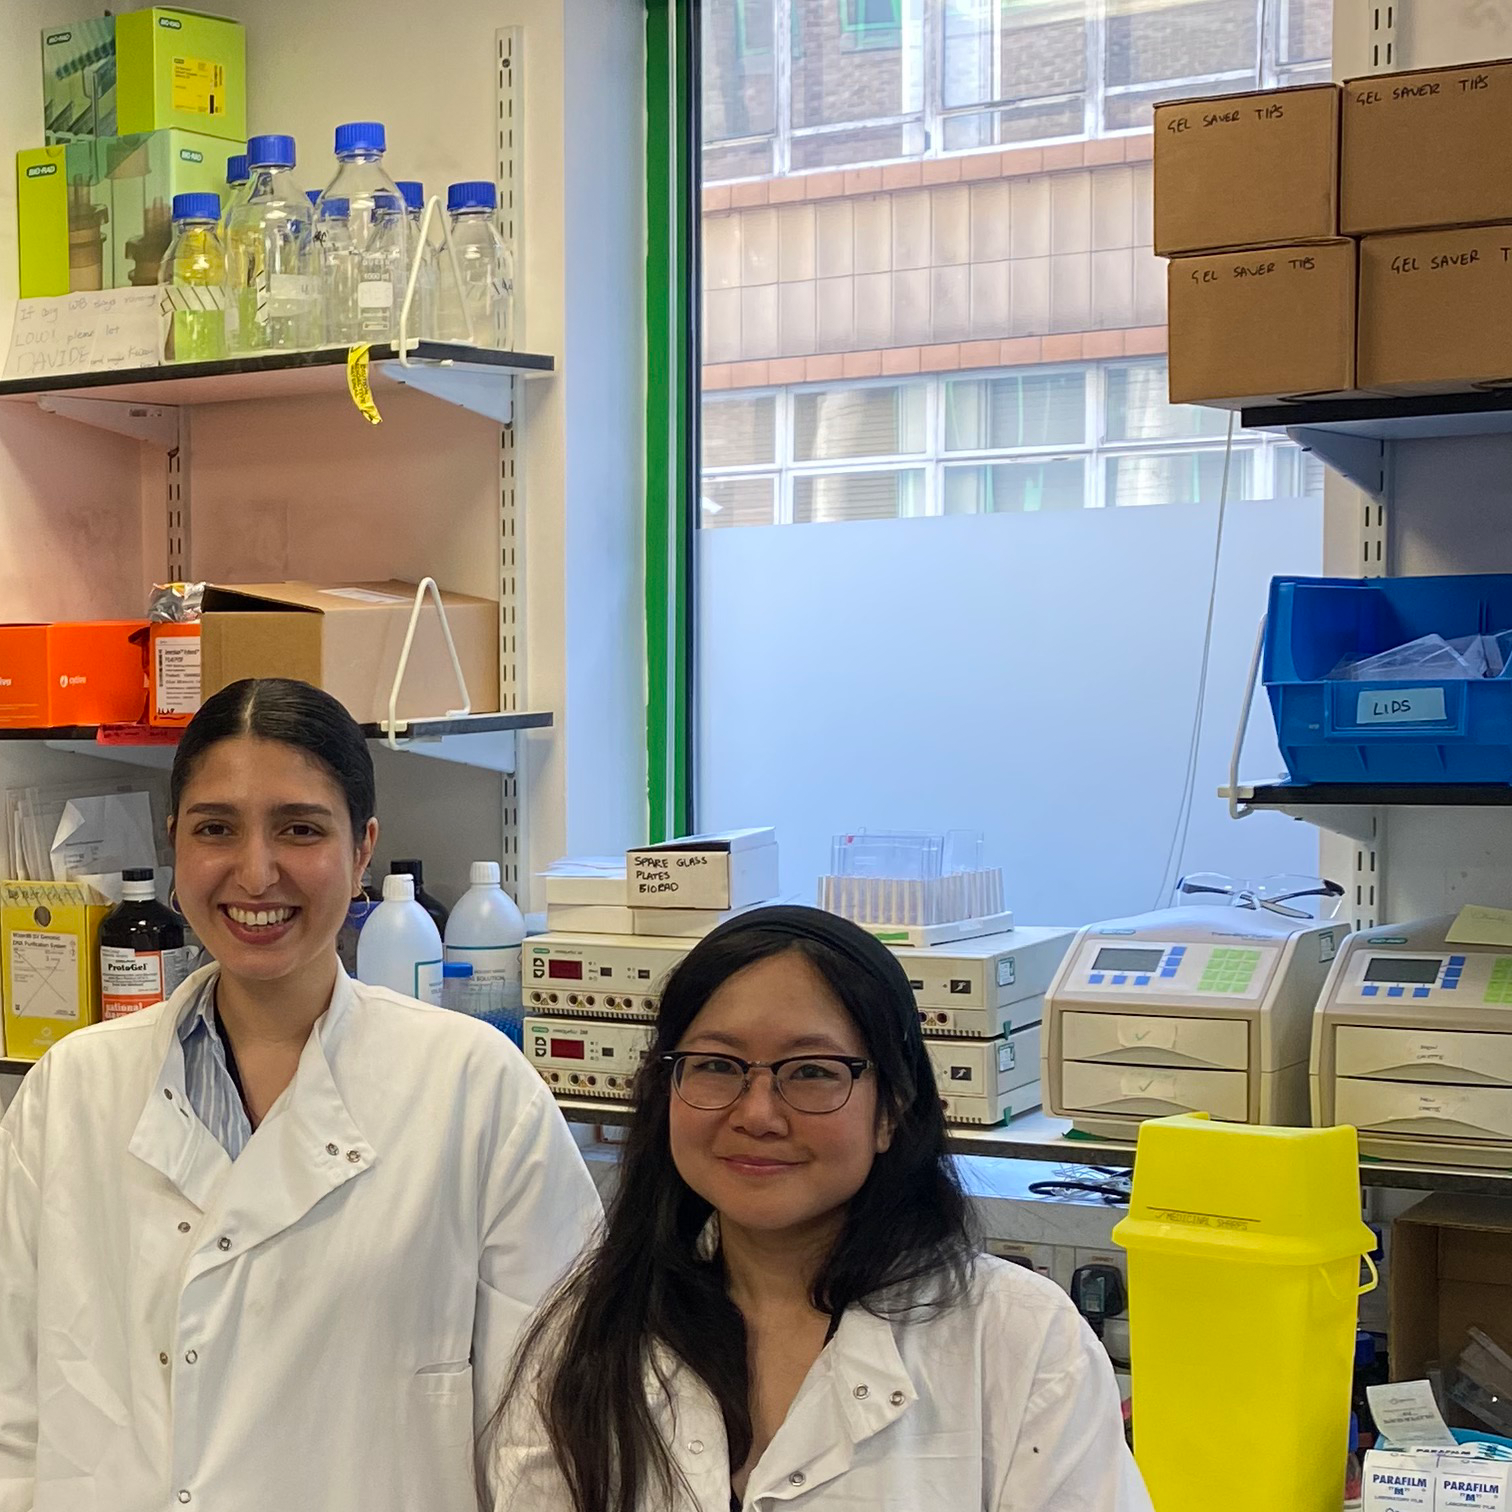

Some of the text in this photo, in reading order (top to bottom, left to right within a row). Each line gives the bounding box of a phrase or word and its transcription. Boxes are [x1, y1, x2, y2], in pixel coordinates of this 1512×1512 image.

[1356, 75, 1488, 106] GEL SAVER TIPS
[1167, 105, 1284, 133] GEL SAVER TIPS
[28, 165, 56, 177] BIO-RAD
[1391, 257, 1420, 275] GEL
[1431, 250, 1480, 270] SAVER
[1191, 257, 1315, 284] GEL SAVER TIPS
[1373, 700, 1411, 716] LIDS
[634, 856, 708, 868] SPARE GLASS
[636, 870, 670, 880] PLATES
[108, 963, 147, 971] ProtoGel
[1373, 1474, 1427, 1487] PARAFILM
[1443, 1480, 1499, 1494] PARAFILM
